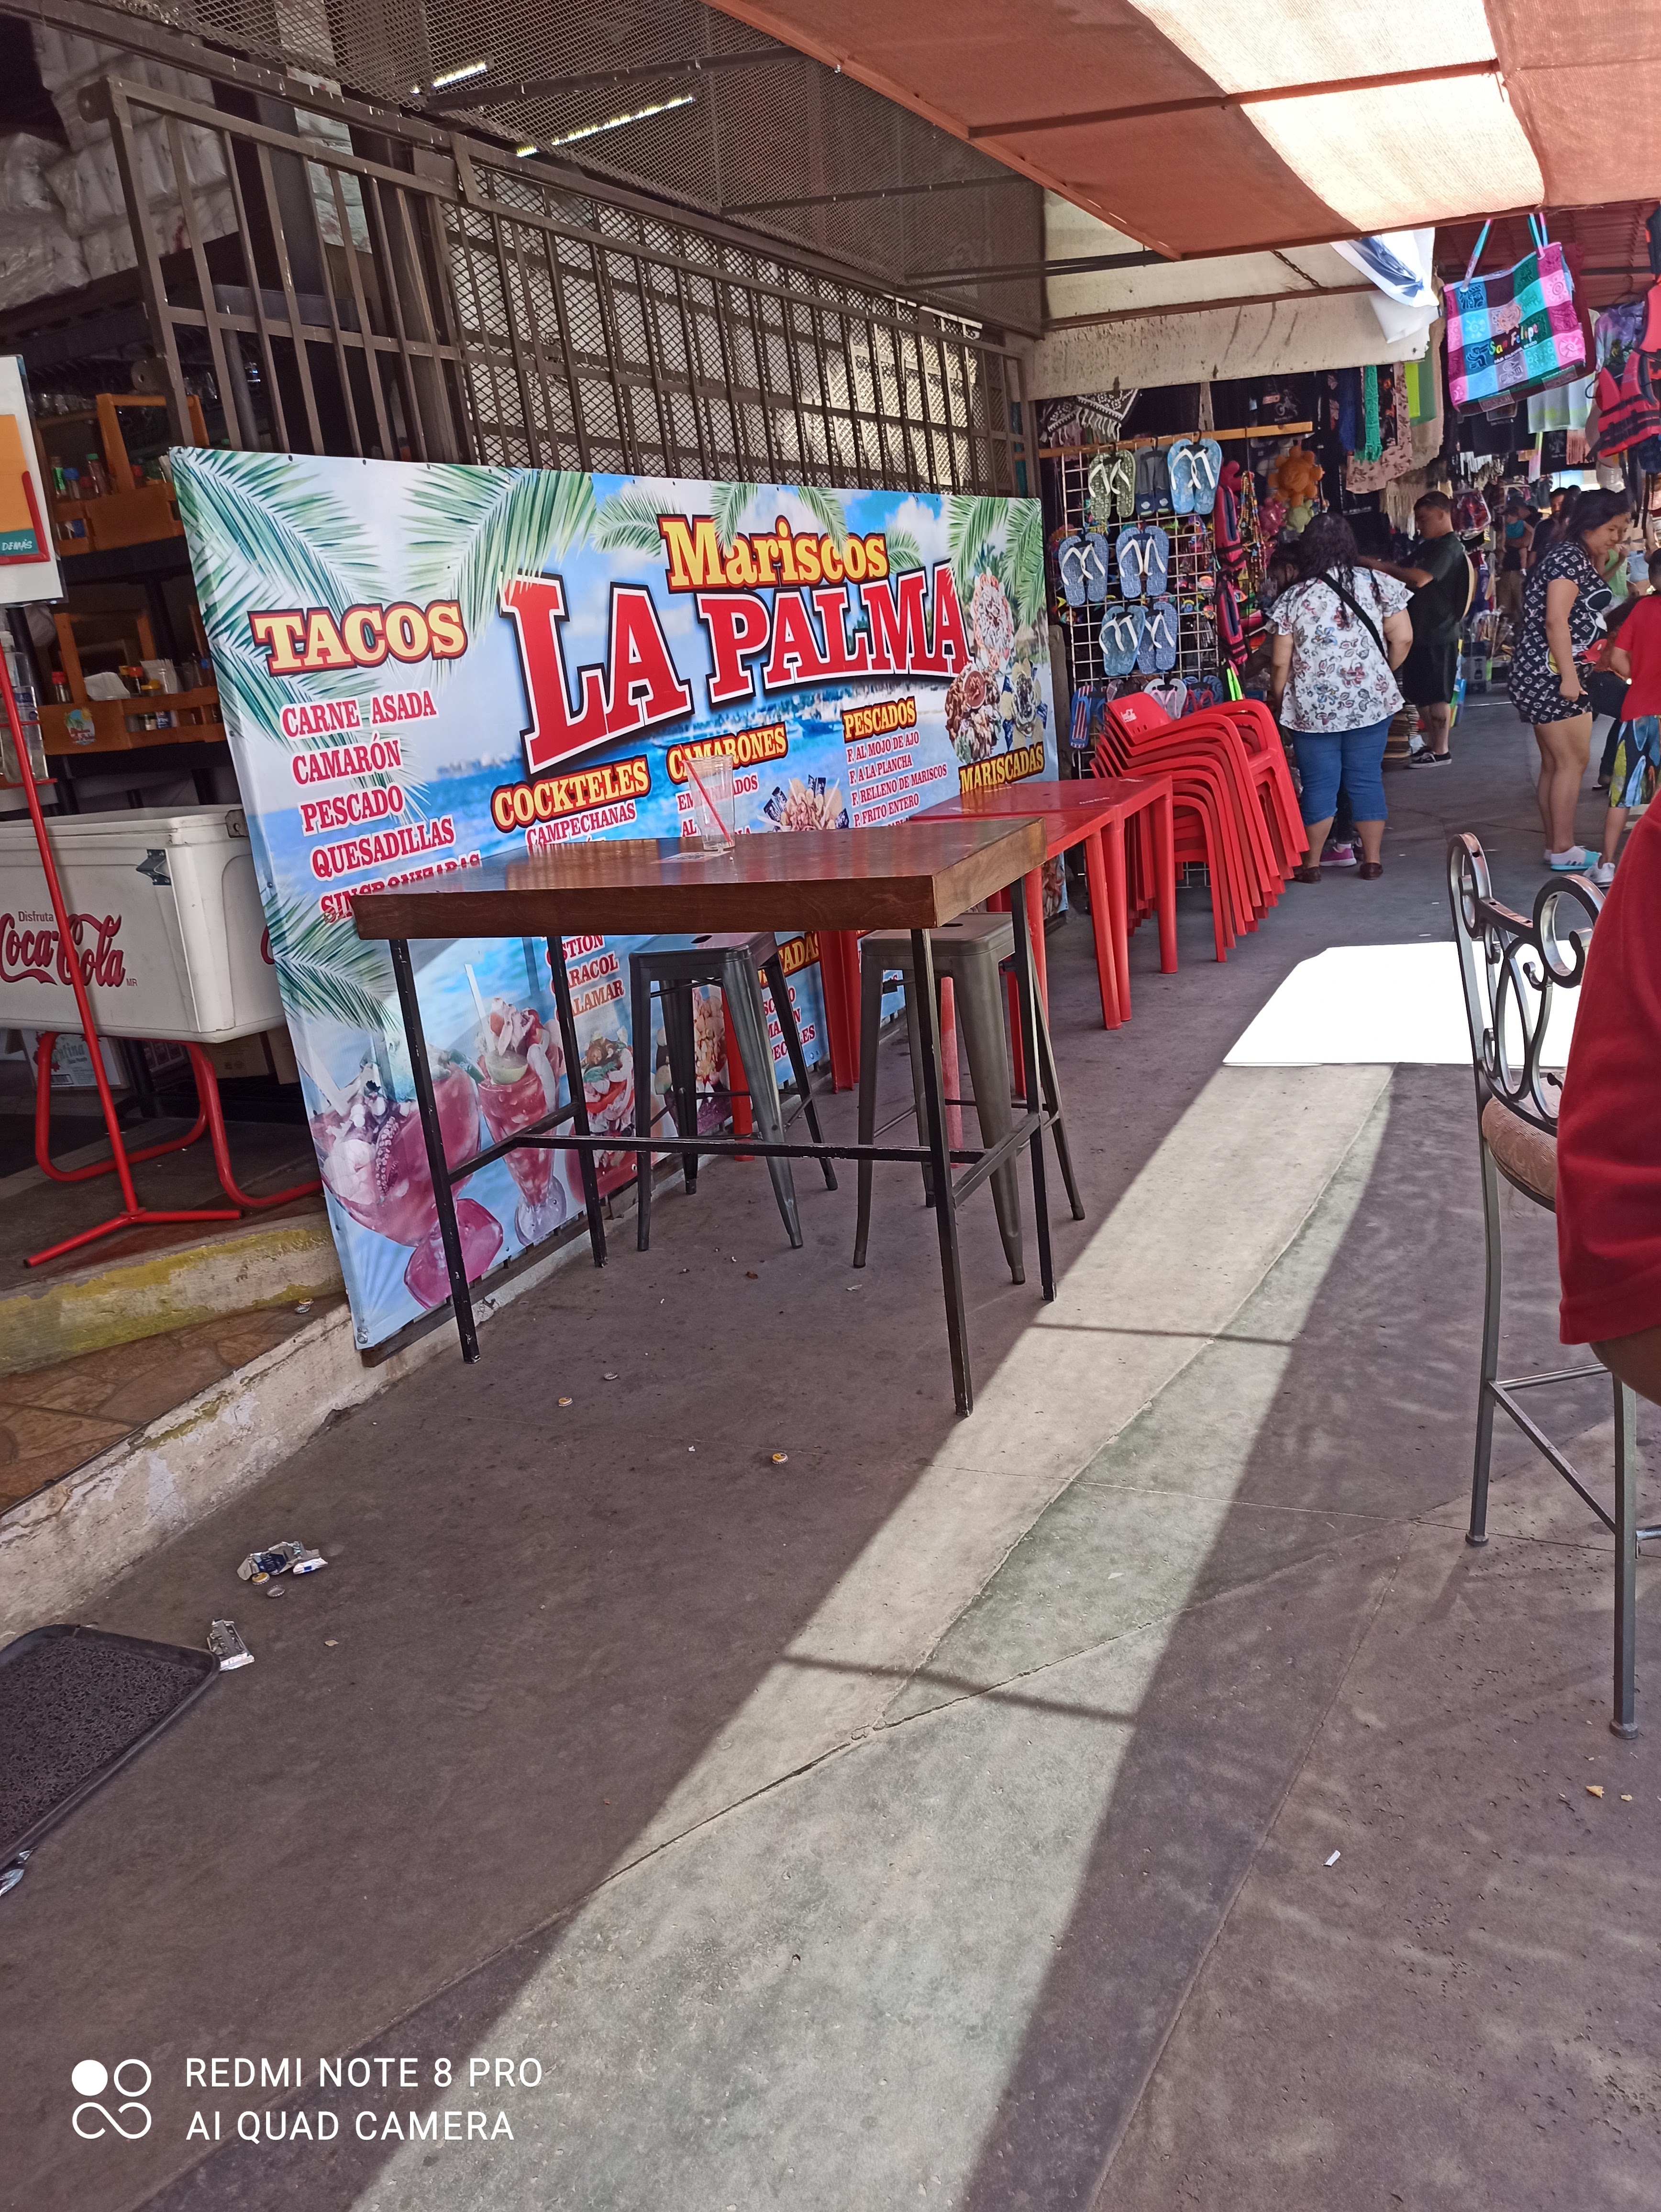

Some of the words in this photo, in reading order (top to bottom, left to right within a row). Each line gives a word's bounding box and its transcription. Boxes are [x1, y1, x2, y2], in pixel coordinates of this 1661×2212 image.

[660, 517, 888, 590] Mariscos
[252, 602, 465, 674] TACOS
[501, 575, 692, 774] LA
[697, 561, 974, 703] PALMA
[282, 699, 360, 737] CARNE
[371, 690, 437, 722] ASADA
[843, 698, 916, 741] PESCADOS
[292, 732, 402, 785] CAMARÓN
[847, 748, 854, 762] F.
[856, 747, 867, 760] AL
[867, 740, 891, 756] MOJO
[892, 735, 904, 750] DE
[905, 731, 919, 746] AJO
[849, 771, 856, 785] F.
[859, 769, 864, 781] A
[865, 766, 877, 779] LA
[877, 754, 912, 776] PLANCHA
[959, 743, 1045, 795] MARISCADAS
[493, 758, 650, 830] COCKTELES
[852, 792, 859, 806] F.
[860, 780, 897, 803] RELLENO
[898, 776, 910, 789] DE
[911, 764, 947, 786] MARISCOS
[300, 785, 403, 832] PESCADO
[526, 802, 636, 847] CAMPECHANAS
[862, 806, 886, 825] FRITO
[888, 793, 919, 814] ENTERO
[312, 817, 454, 878] QUESADILLAS
[18, 911, 54, 922] Disfruta
[0, 913, 126, 987] Coca-Cola
[126, 978, 138, 987] MR
[552, 953, 618, 994] RACOL
[556, 979, 624, 1022] LAMAR
